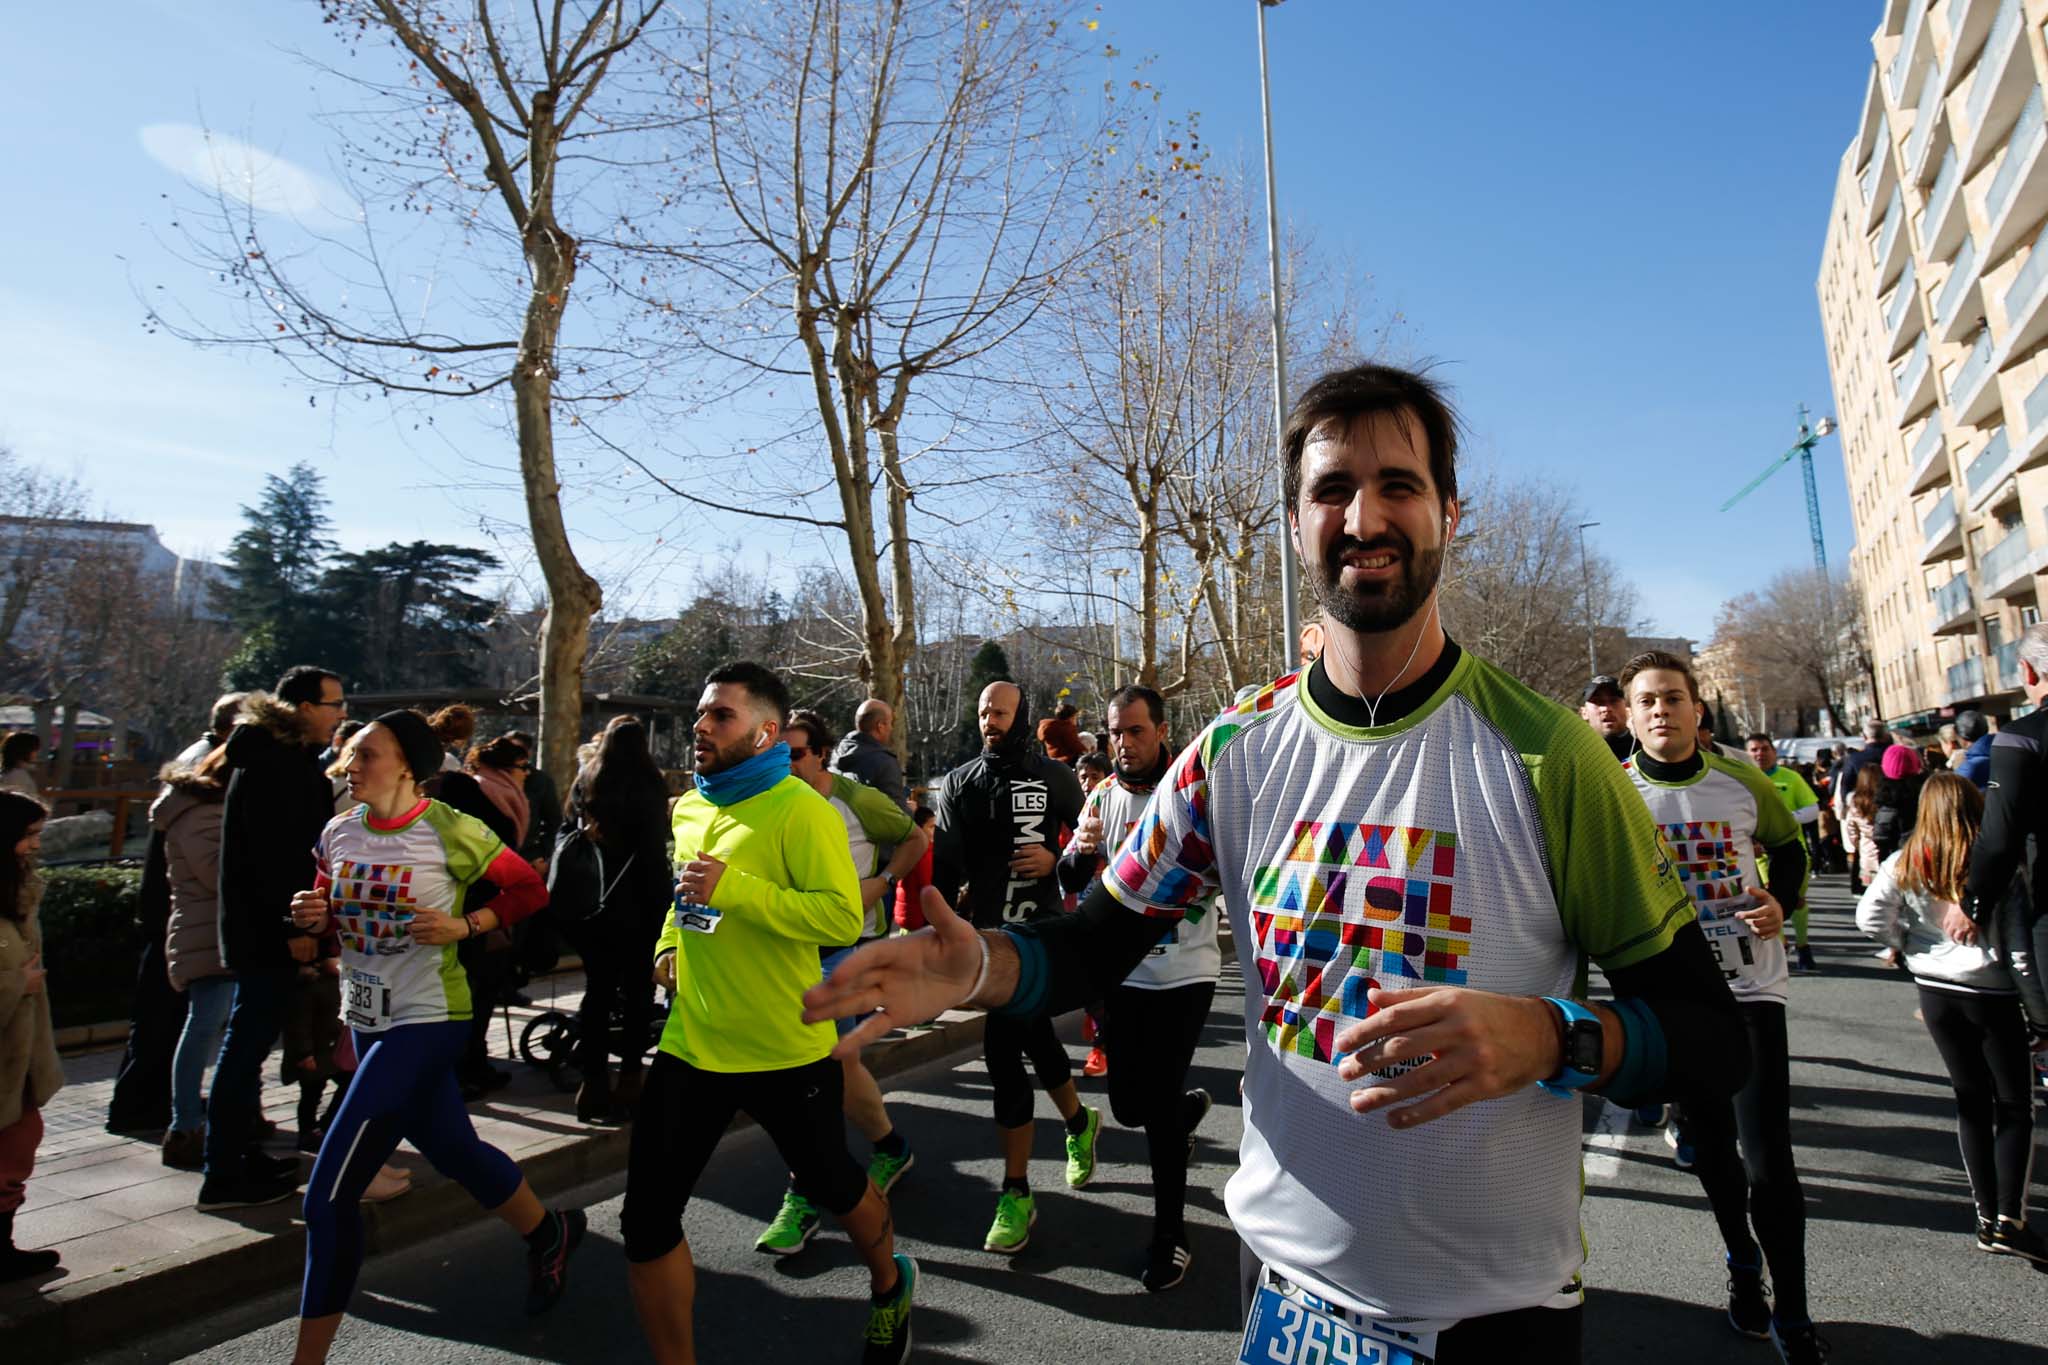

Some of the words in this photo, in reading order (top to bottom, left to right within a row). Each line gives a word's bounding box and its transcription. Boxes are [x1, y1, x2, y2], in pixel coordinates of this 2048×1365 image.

[1014, 794, 1046, 810] LES
[1002, 815, 1046, 923] MLS
[1286, 820, 1457, 878] XXXVI
[1363, 875, 1472, 933] SIL
[1704, 925, 1737, 938] TEL
[1252, 910, 1471, 986] VESTRE
[1257, 956, 1382, 1020] SALM
[1260, 1005, 1352, 1066] TIN
